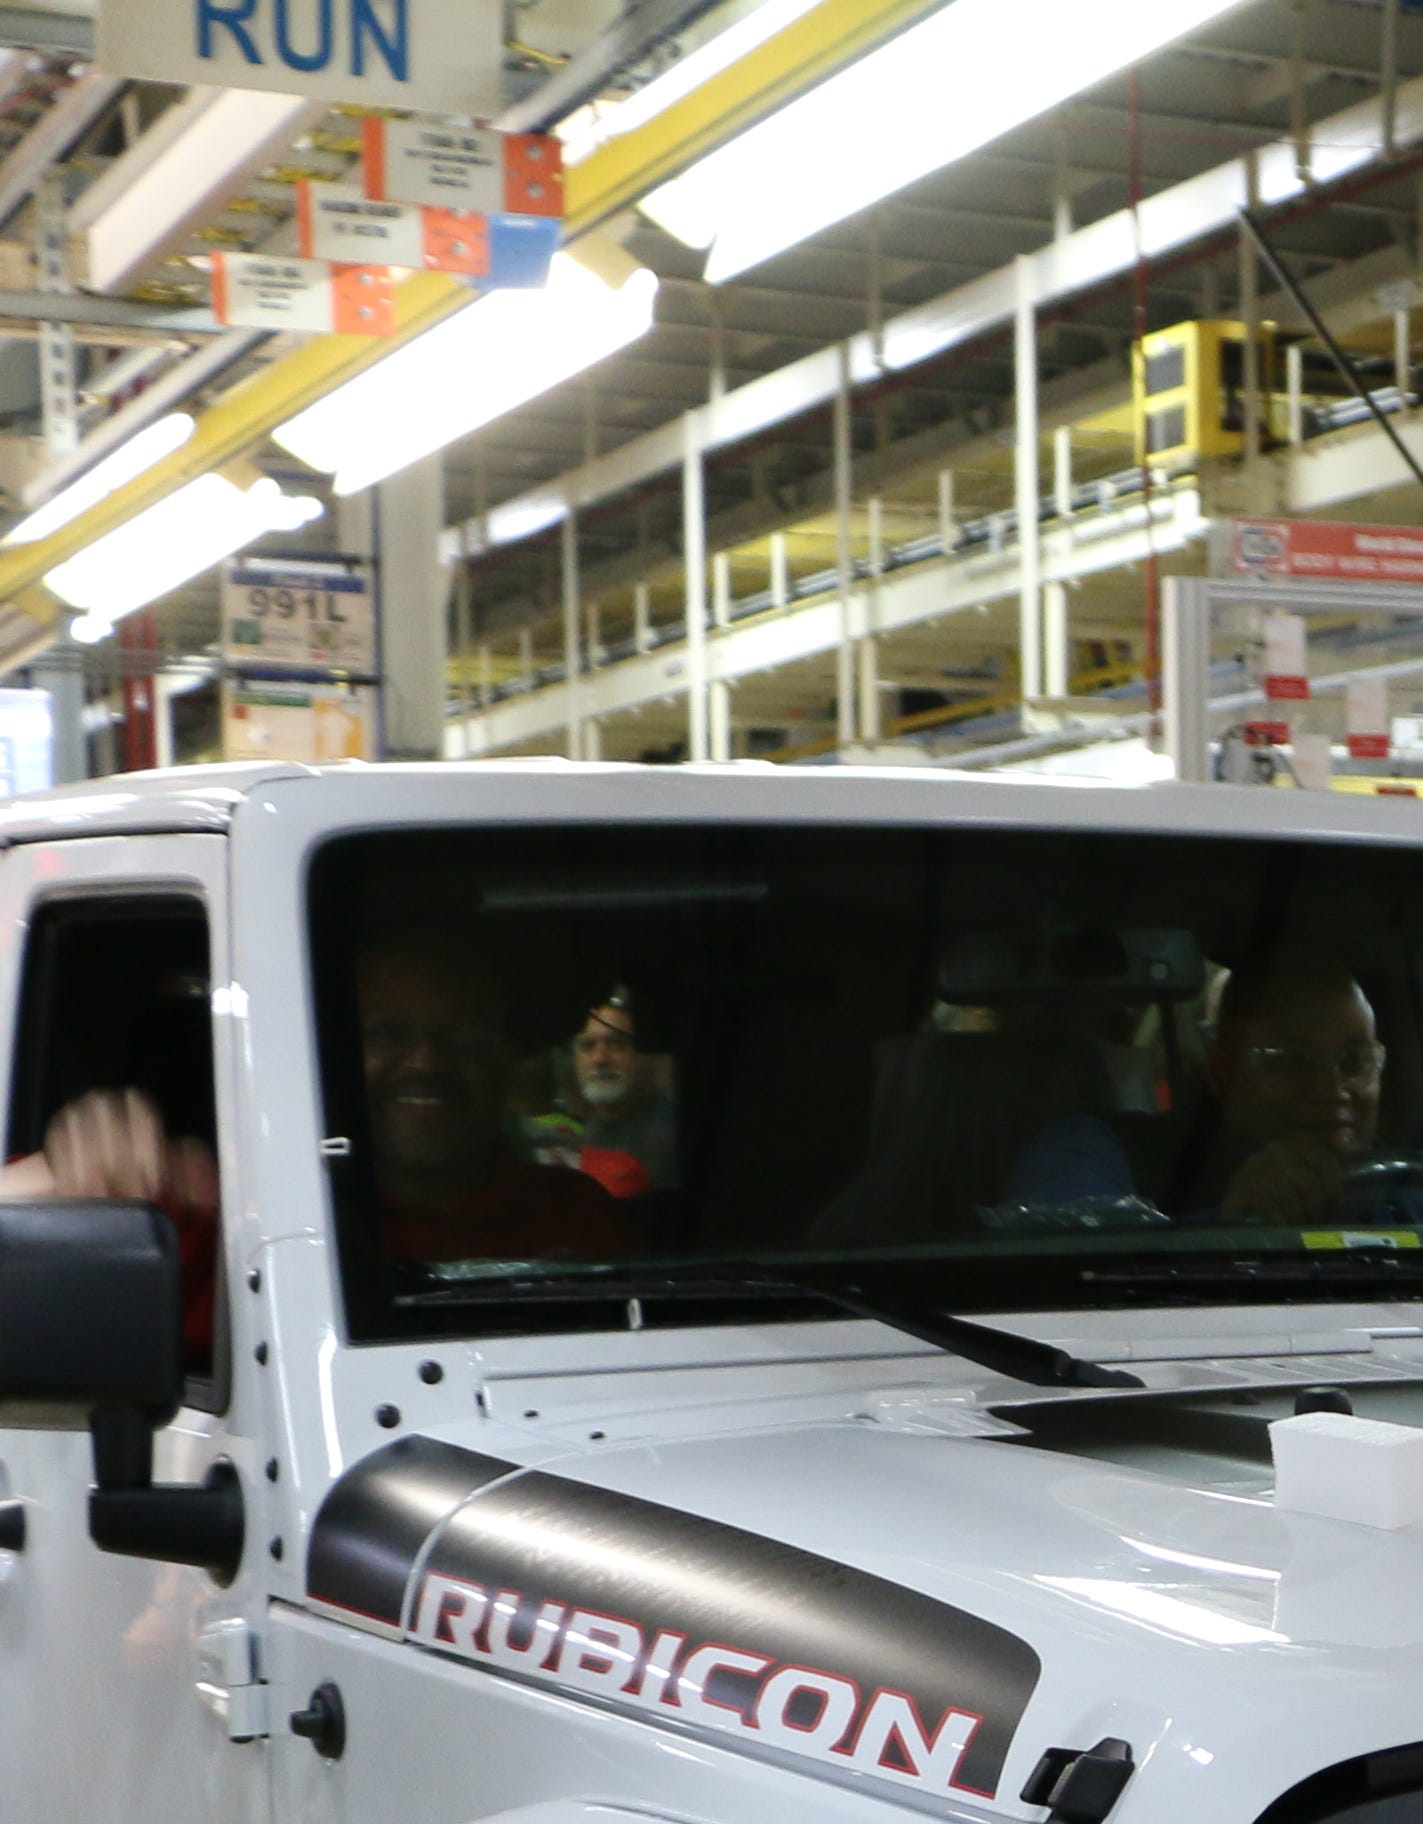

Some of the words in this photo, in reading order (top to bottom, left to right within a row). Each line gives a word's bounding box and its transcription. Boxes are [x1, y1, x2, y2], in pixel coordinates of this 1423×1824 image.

[197, 0, 410, 82] RUN
[248, 588, 346, 622] 991L
[411, 1569, 997, 1800] RUBICON
